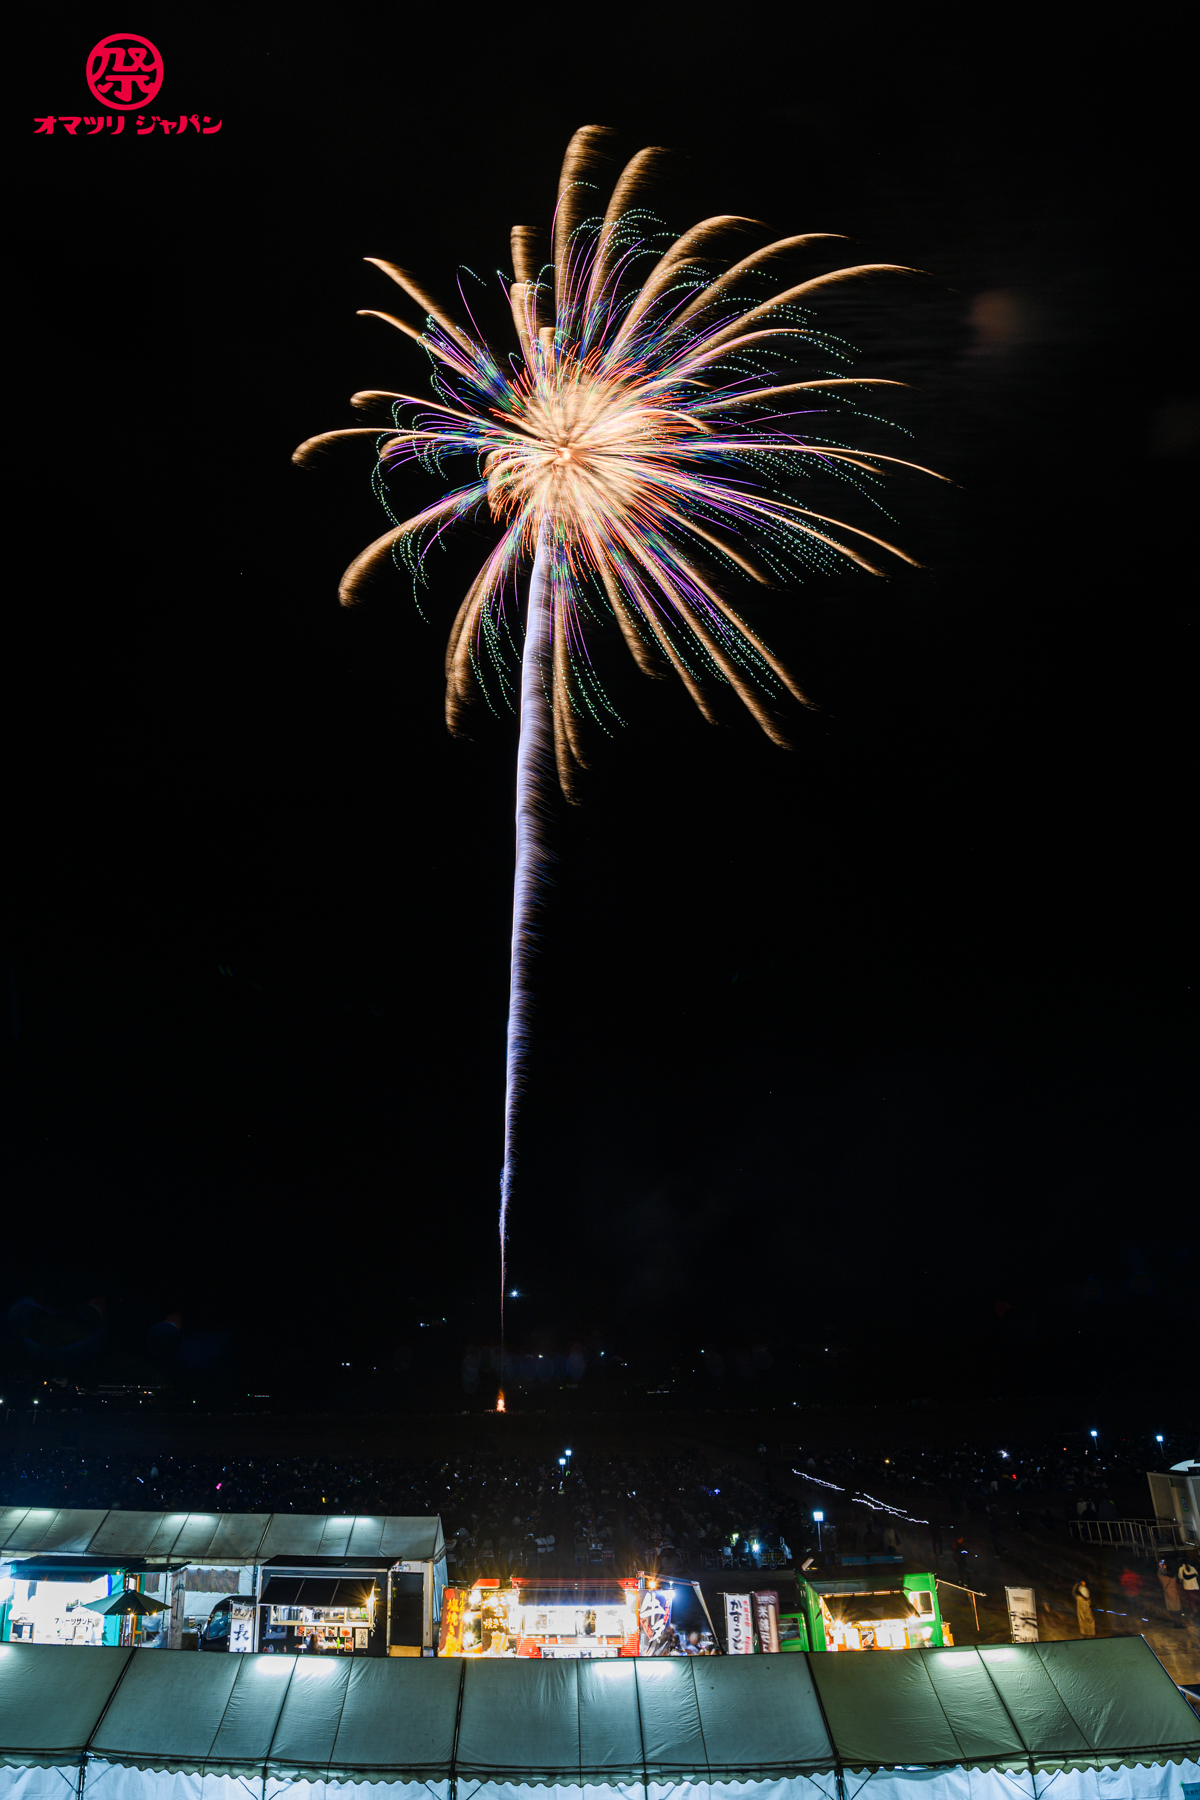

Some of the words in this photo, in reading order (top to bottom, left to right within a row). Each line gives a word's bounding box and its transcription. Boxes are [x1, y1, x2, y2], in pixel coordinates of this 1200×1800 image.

[55, 1617, 93, 1626] フーツサンド
[729, 1599, 743, 1653] かすうど
